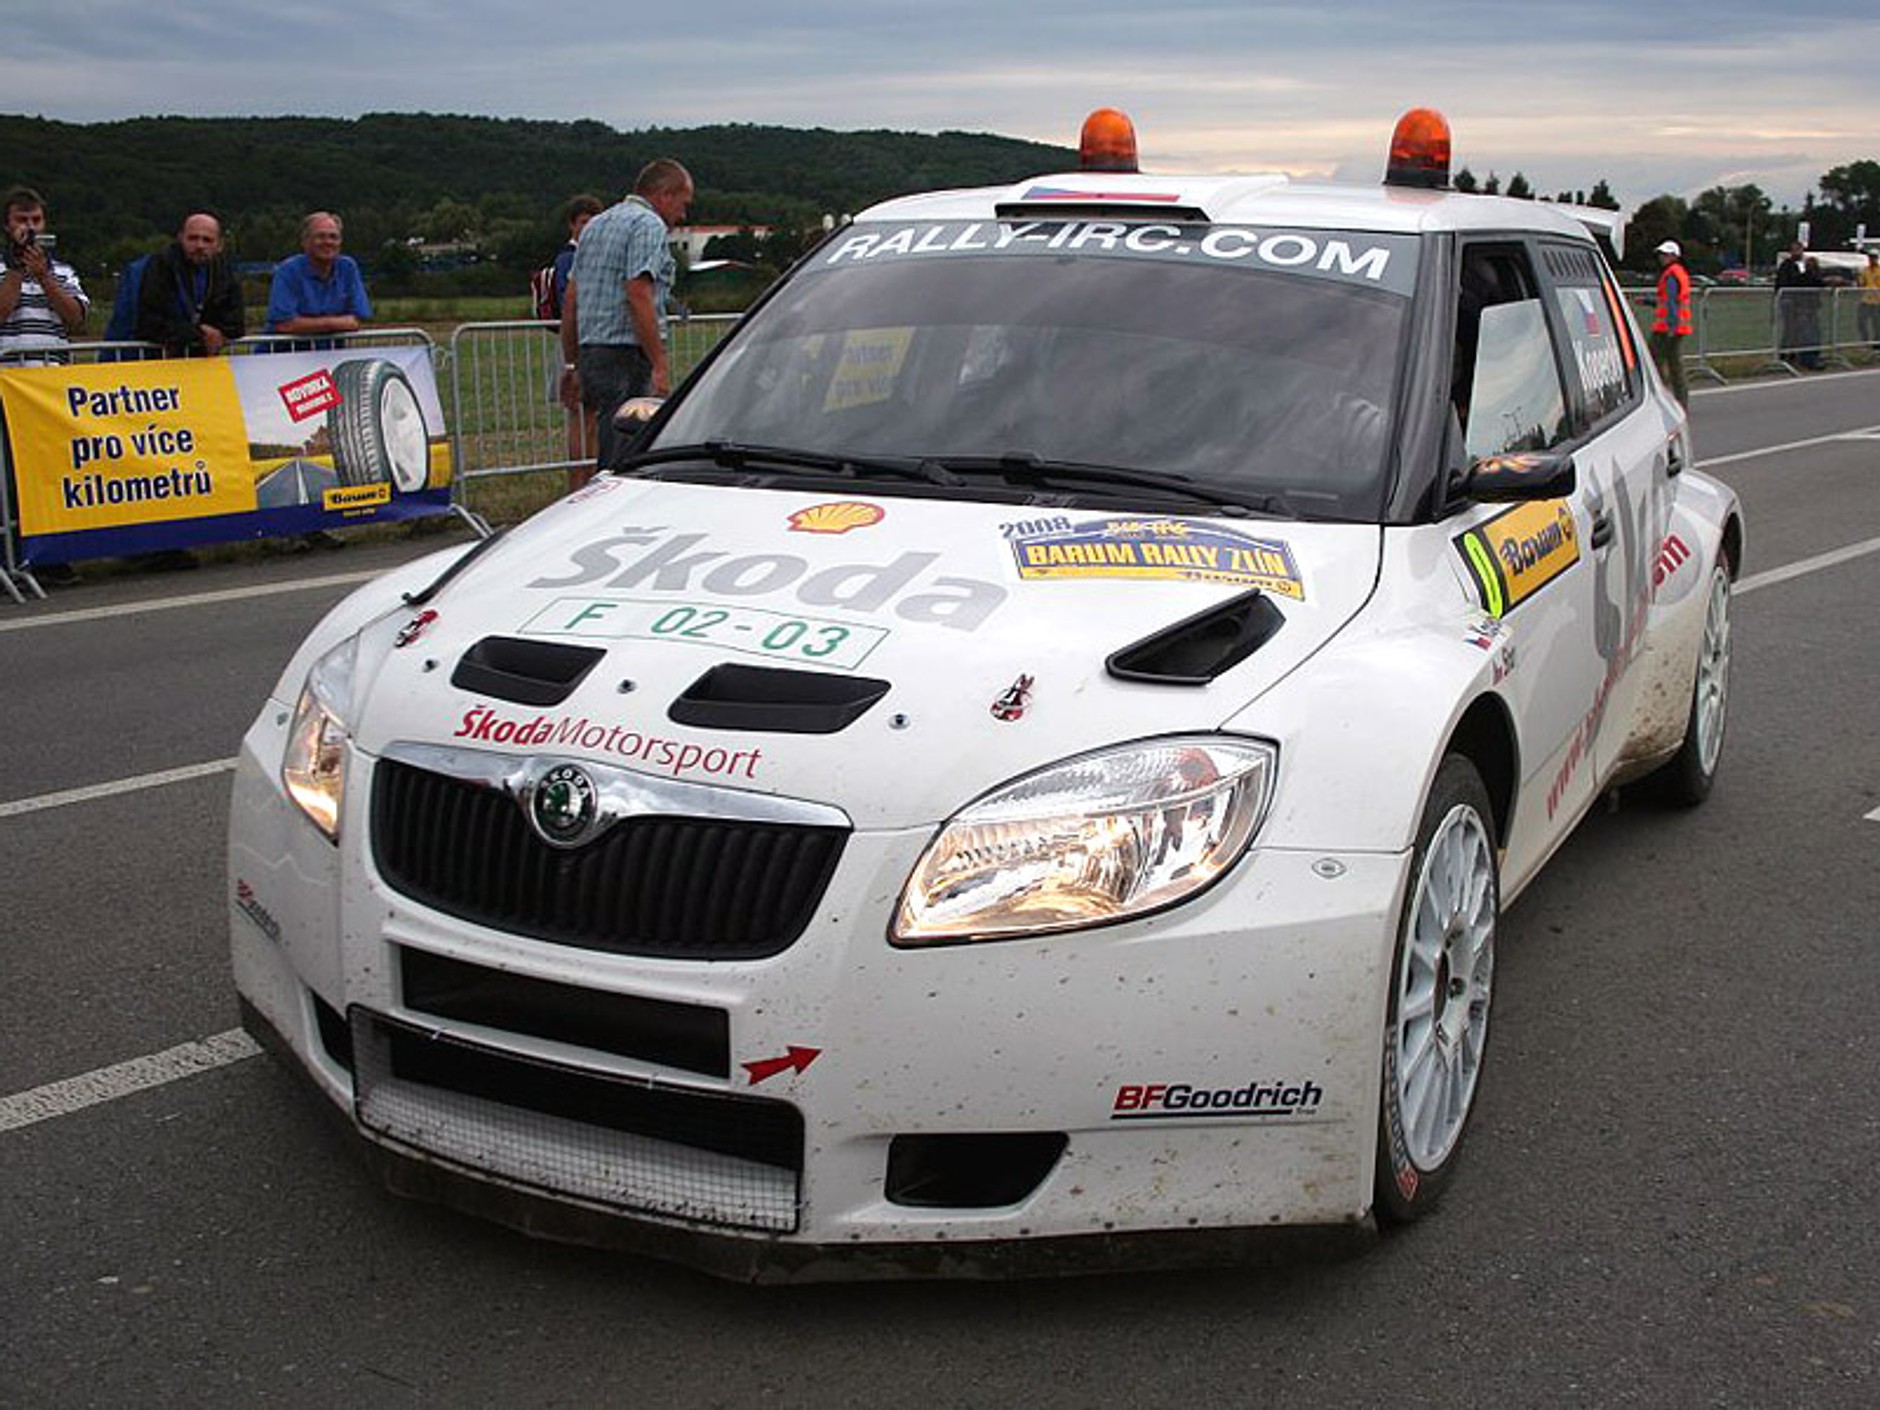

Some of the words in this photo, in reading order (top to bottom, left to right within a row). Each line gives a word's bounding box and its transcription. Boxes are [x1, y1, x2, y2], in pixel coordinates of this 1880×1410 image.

[826, 221, 1391, 280] RALLY-IRC.COM
[67, 385, 180, 417] Partner
[72, 435, 124, 470] pro
[130, 423, 194, 456] více
[62, 460, 212, 509] kilometrů
[999, 515, 1074, 539] 2008
[1025, 542, 1138, 566] BARUM
[1139, 542, 1219, 569] RALLY
[525, 526, 1010, 632] Škoda
[564, 603, 619, 630] F
[1114, 1080, 1323, 1110] BFGoodrich
